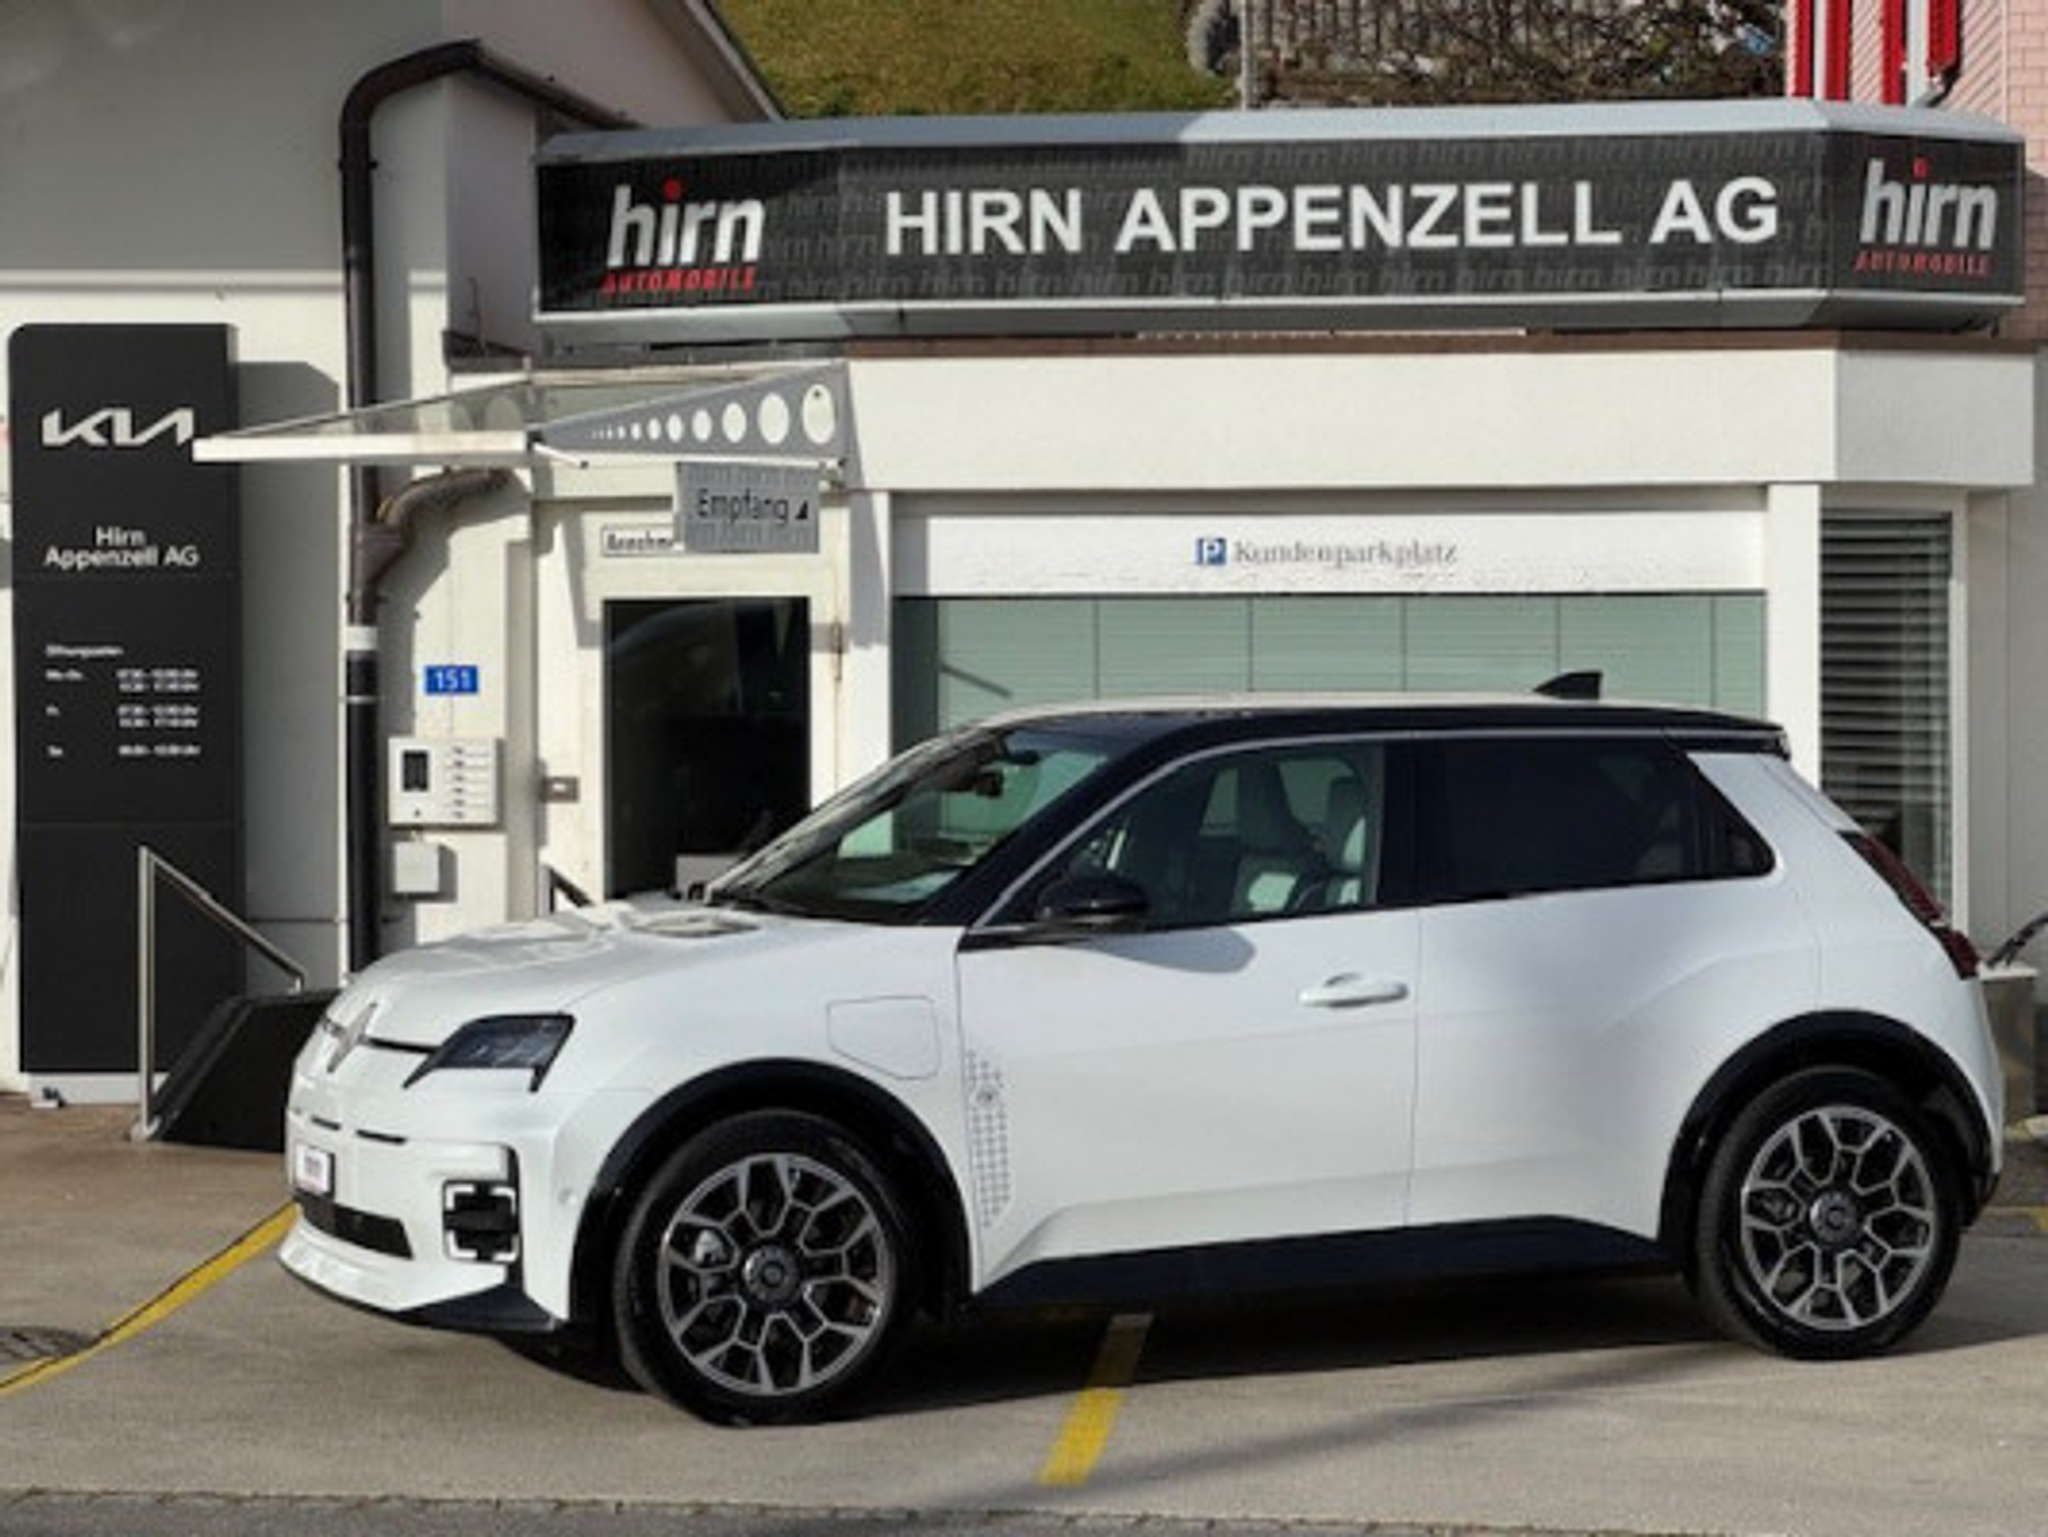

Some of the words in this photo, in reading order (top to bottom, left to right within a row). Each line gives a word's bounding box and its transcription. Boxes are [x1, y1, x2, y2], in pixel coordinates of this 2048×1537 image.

[886, 187, 1081, 255] HIRN
[1115, 181, 1622, 252] APPENZELL
[1648, 177, 1778, 245] AG
[1860, 157, 1998, 249] hirn
[607, 179, 765, 267] hirn
[1854, 251, 1991, 276] AUTOMOBILE
[602, 268, 756, 294] AUTOMOBILE
[42, 407, 194, 447] KIA
[696, 488, 789, 526] Empfang
[95, 525, 146, 547] Hirn
[45, 546, 158, 571] Appenzell
[164, 546, 200, 566] AG
[1234, 539, 1458, 568] Kundenparkplatz
[434, 671, 471, 690] 151
